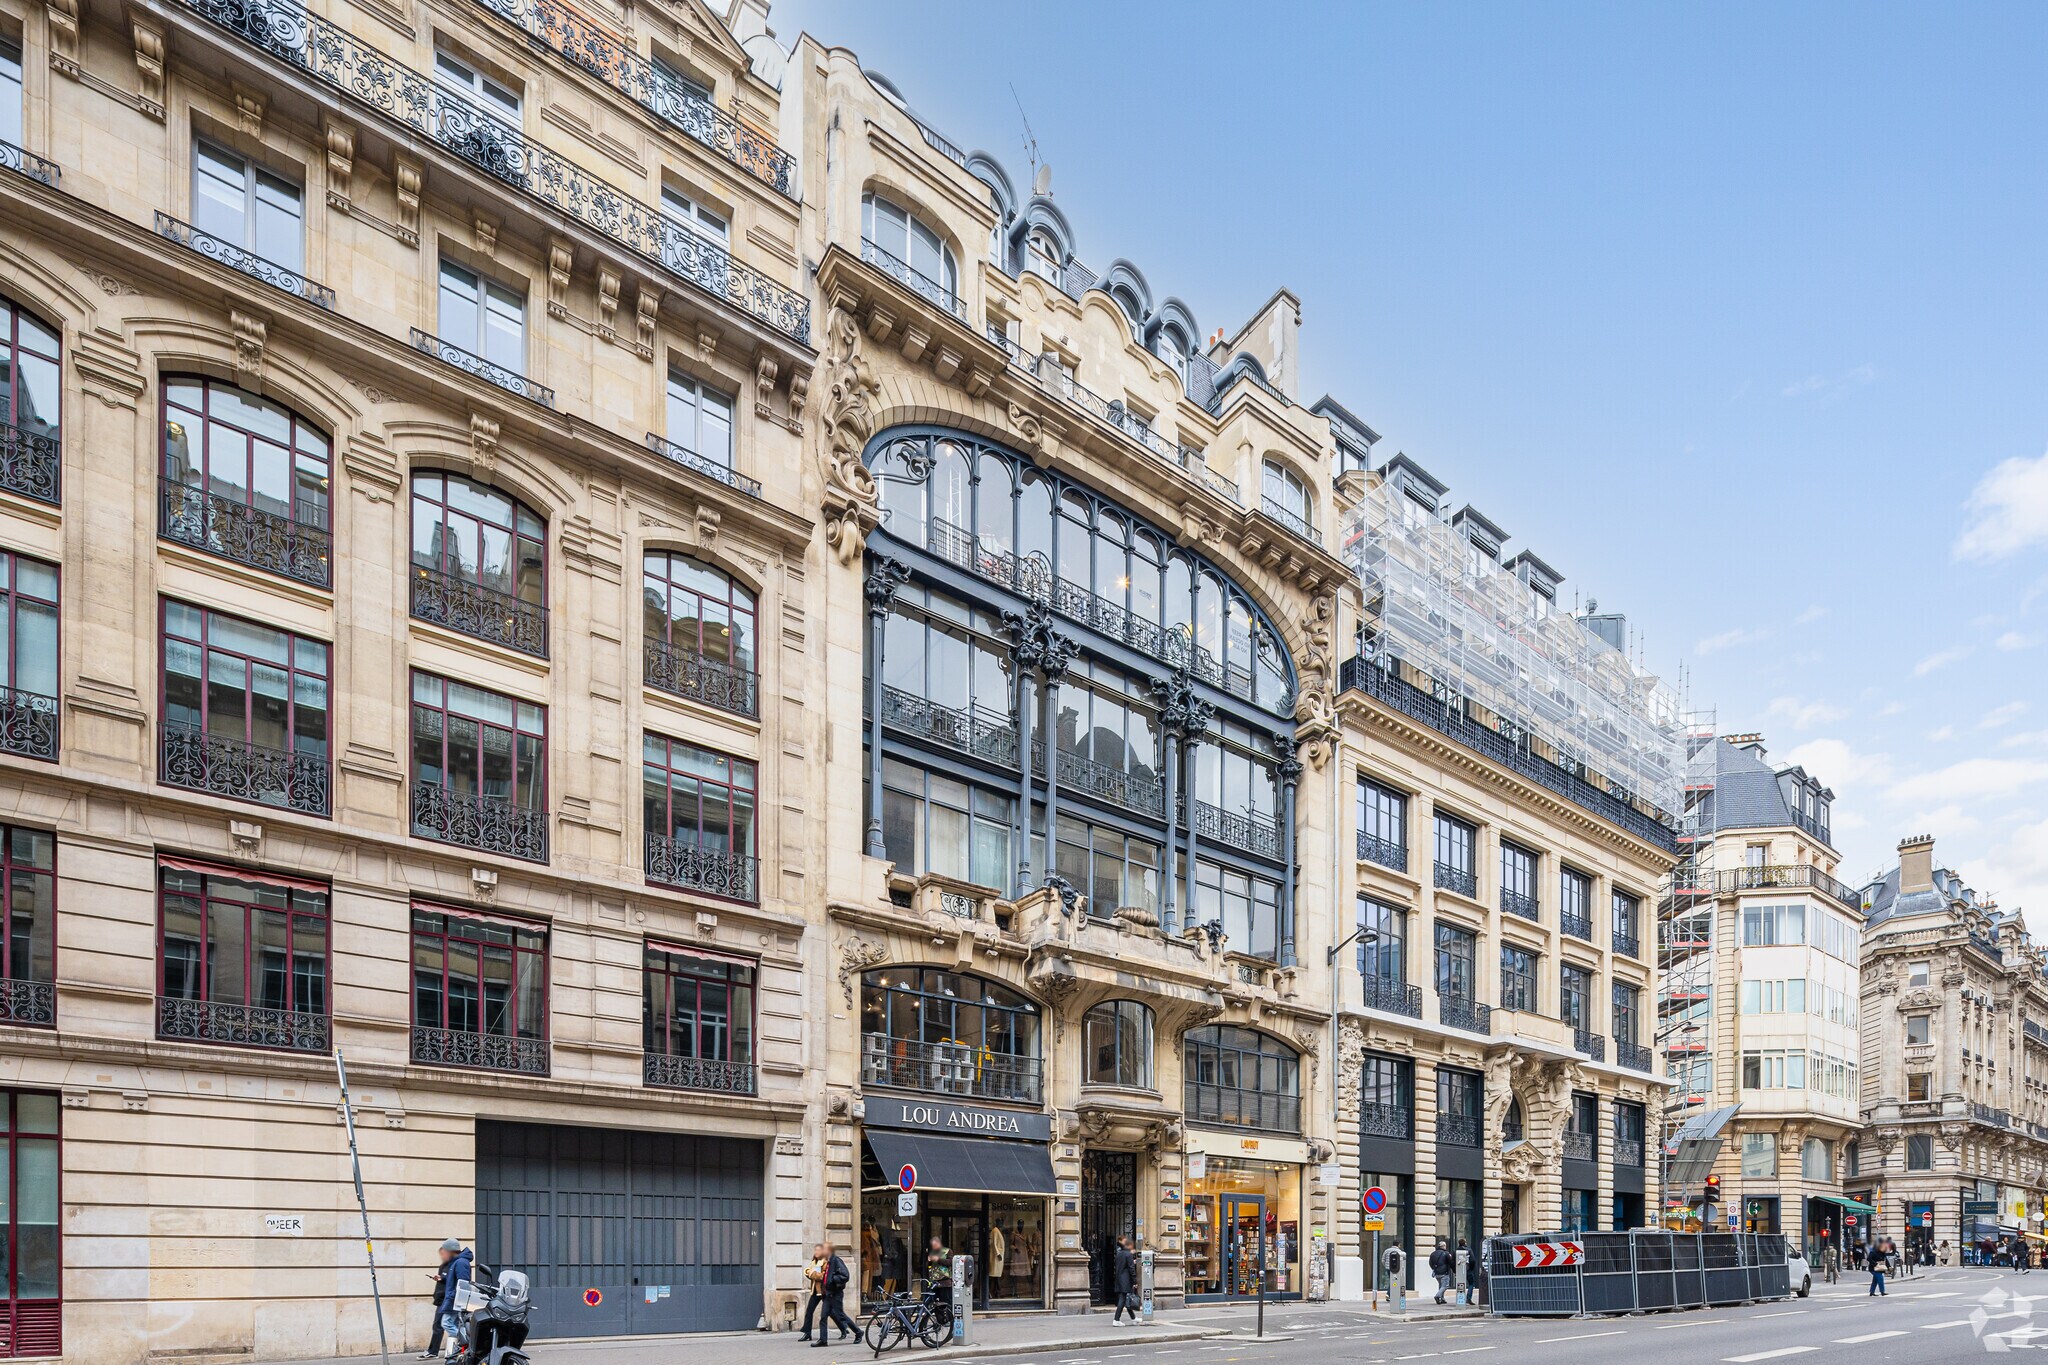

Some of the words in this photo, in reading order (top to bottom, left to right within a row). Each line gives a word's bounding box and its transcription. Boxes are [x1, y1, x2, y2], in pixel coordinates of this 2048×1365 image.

[902, 1105, 940, 1125] LOU
[946, 1111, 1019, 1133] ANDREA
[862, 1196, 882, 1205] LOU
